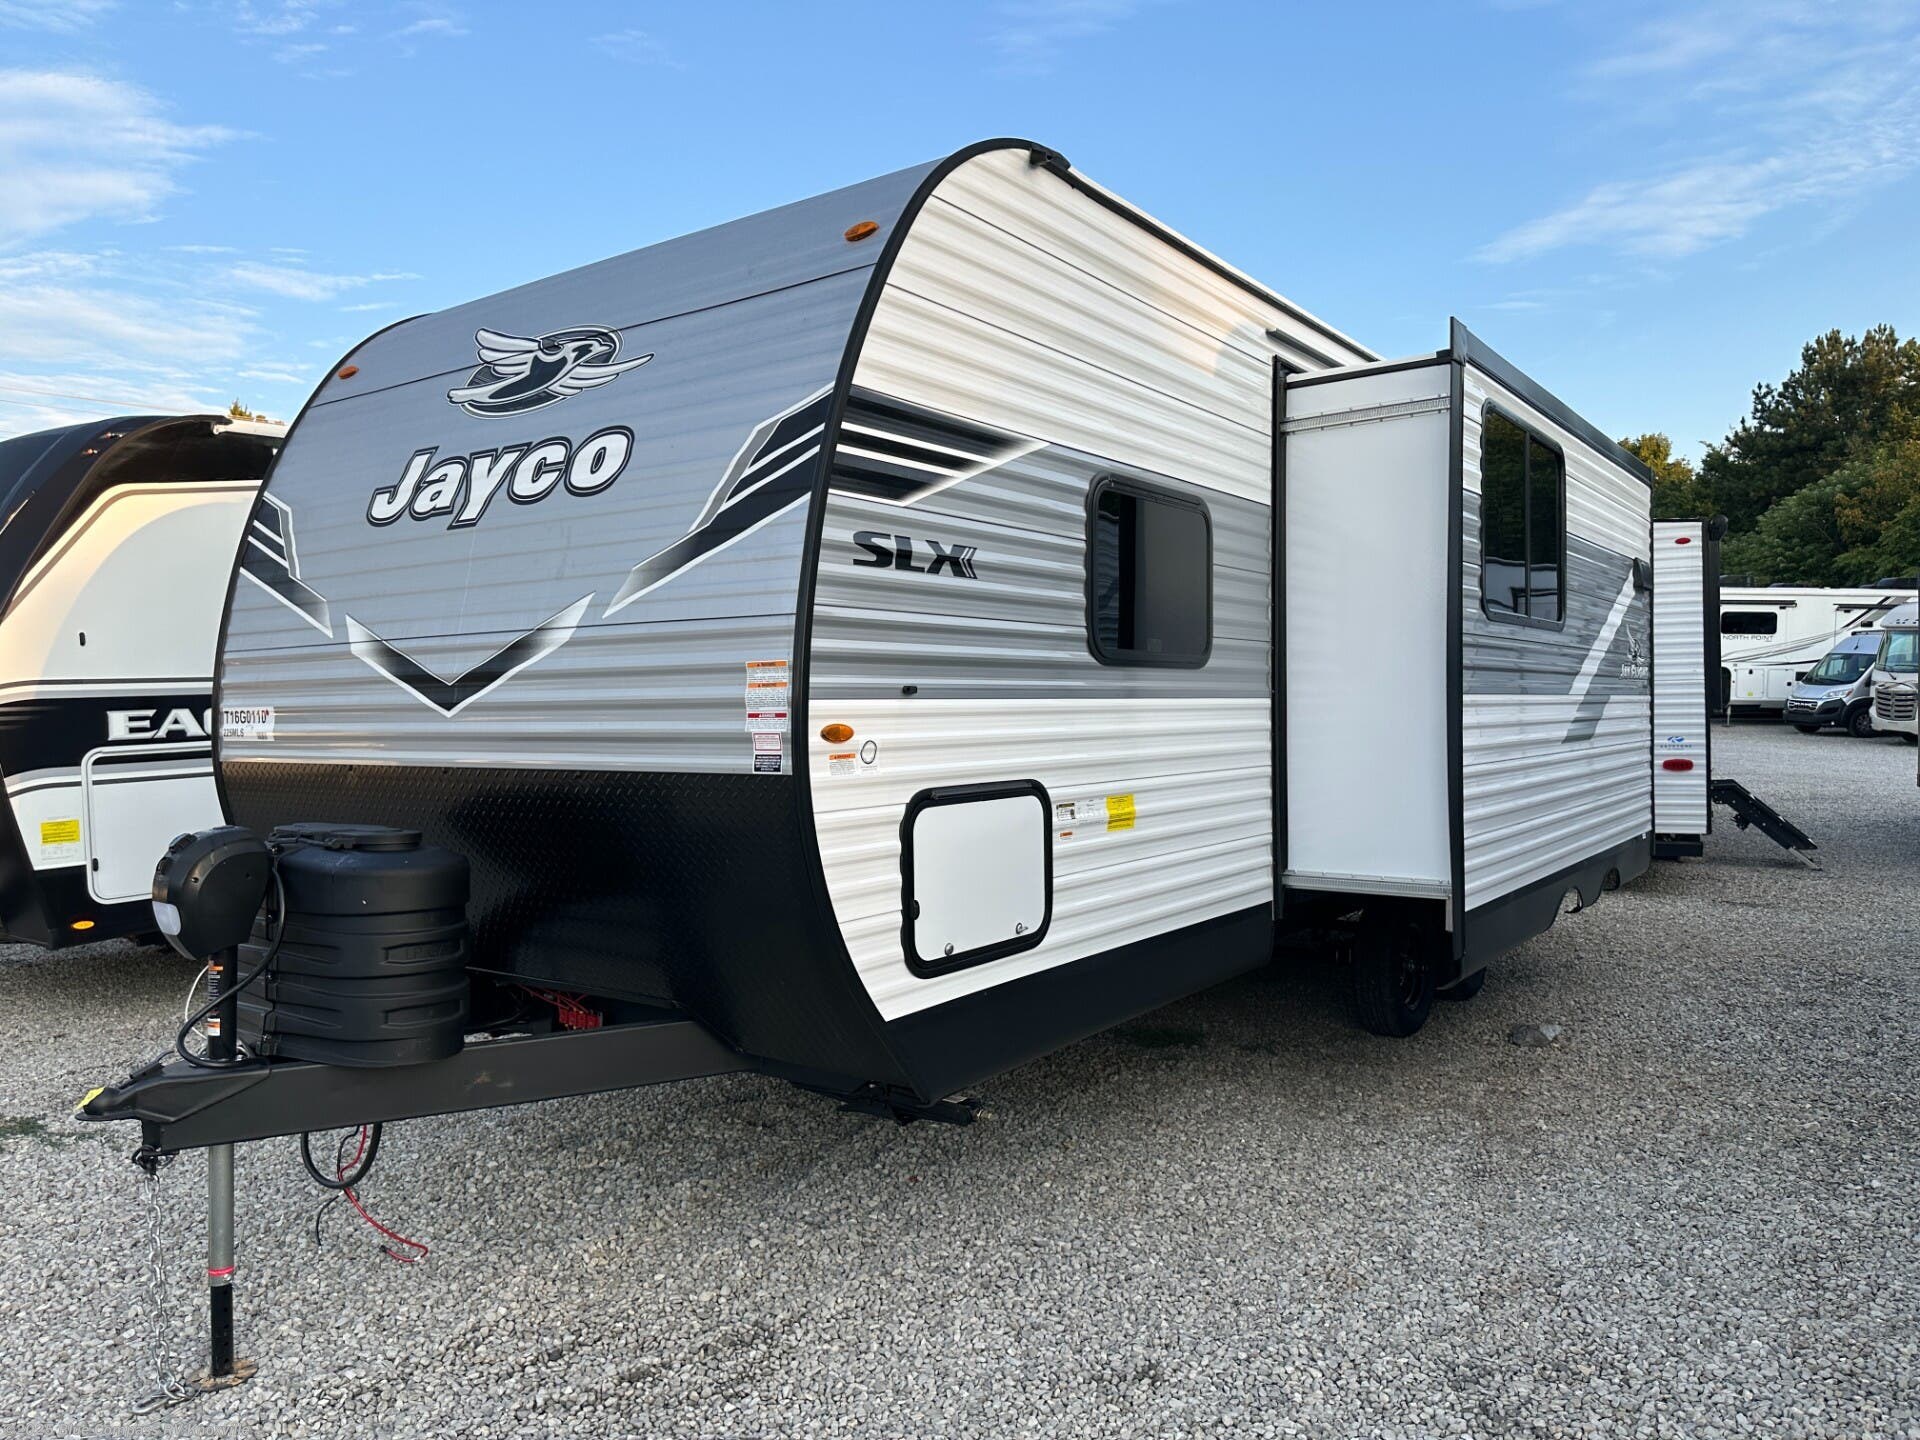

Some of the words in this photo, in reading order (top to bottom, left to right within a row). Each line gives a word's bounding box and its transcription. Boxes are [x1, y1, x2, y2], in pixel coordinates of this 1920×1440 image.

[366, 425, 635, 531] Jayco
[852, 530, 978, 580] SLX
[106, 708, 212, 741] EA
